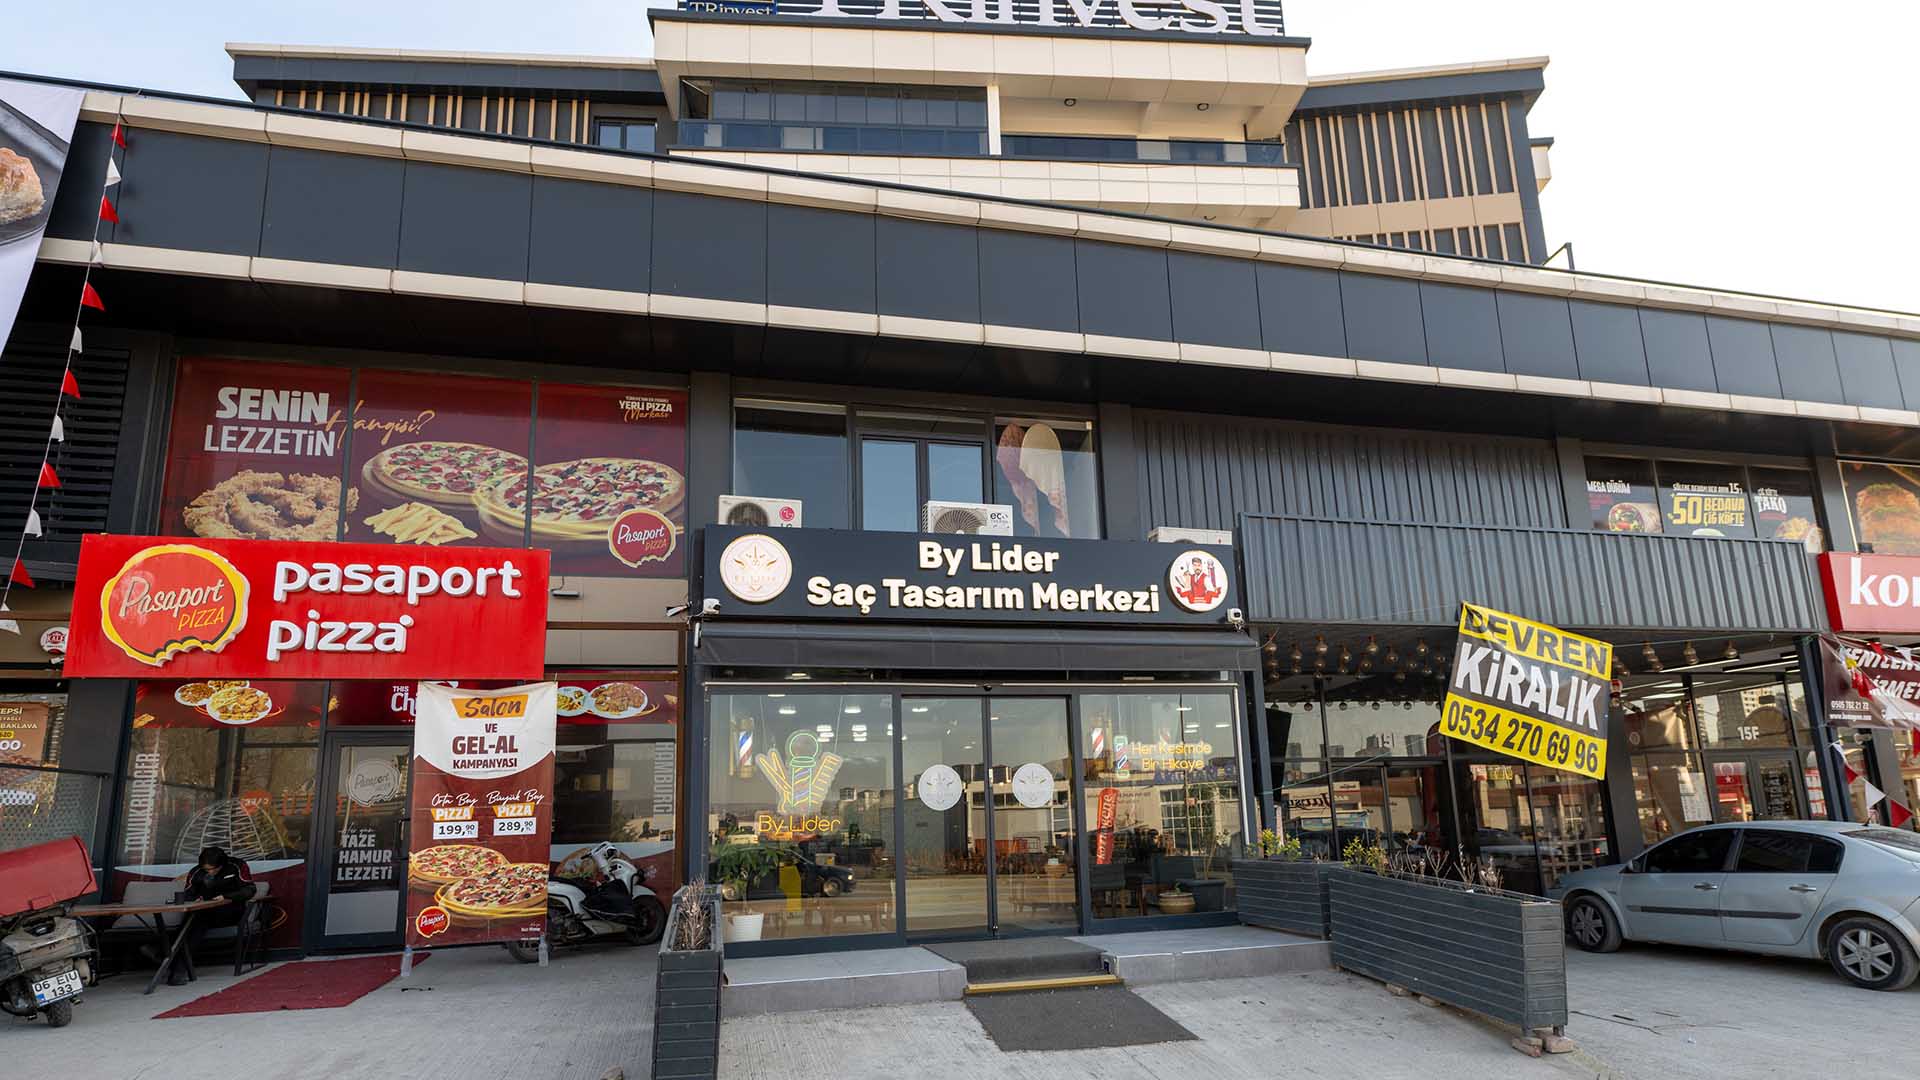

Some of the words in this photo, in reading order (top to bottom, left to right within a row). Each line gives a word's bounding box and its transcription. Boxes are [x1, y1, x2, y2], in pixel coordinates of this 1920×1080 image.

[1672, 496, 1702, 525] 50
[617, 524, 665, 545] Pasaport
[919, 541, 964, 576] By
[971, 543, 1060, 573] Lider
[273, 561, 522, 606] pasaport
[119, 576, 225, 618] Pasaport
[807, 576, 877, 614] Saç
[882, 578, 1024, 610] Tasarım
[1032, 581, 1160, 613] Merkezi
[266, 609, 415, 662] pizza
[1464, 606, 1608, 675] DEVREN
[464, 698, 522, 718] Salon
[485, 723, 498, 733] VE
[1447, 700, 1501, 744] 0534
[1502, 718, 1543, 757] 270
[1546, 730, 1570, 765] 69
[1574, 738, 1598, 773] 96
[1737, 726, 1760, 740] 15F
[452, 735, 519, 755] GEL-AL
[452, 758, 518, 769] KAMPANYASI
[758, 815, 783, 834] By
[789, 815, 841, 833] Lider
[341, 834, 376, 848] TAZE
[339, 849, 393, 864] HAMUR
[34, 980, 50, 993] 06
[57, 970, 79, 985] EIU
[51, 984, 73, 997] 133
